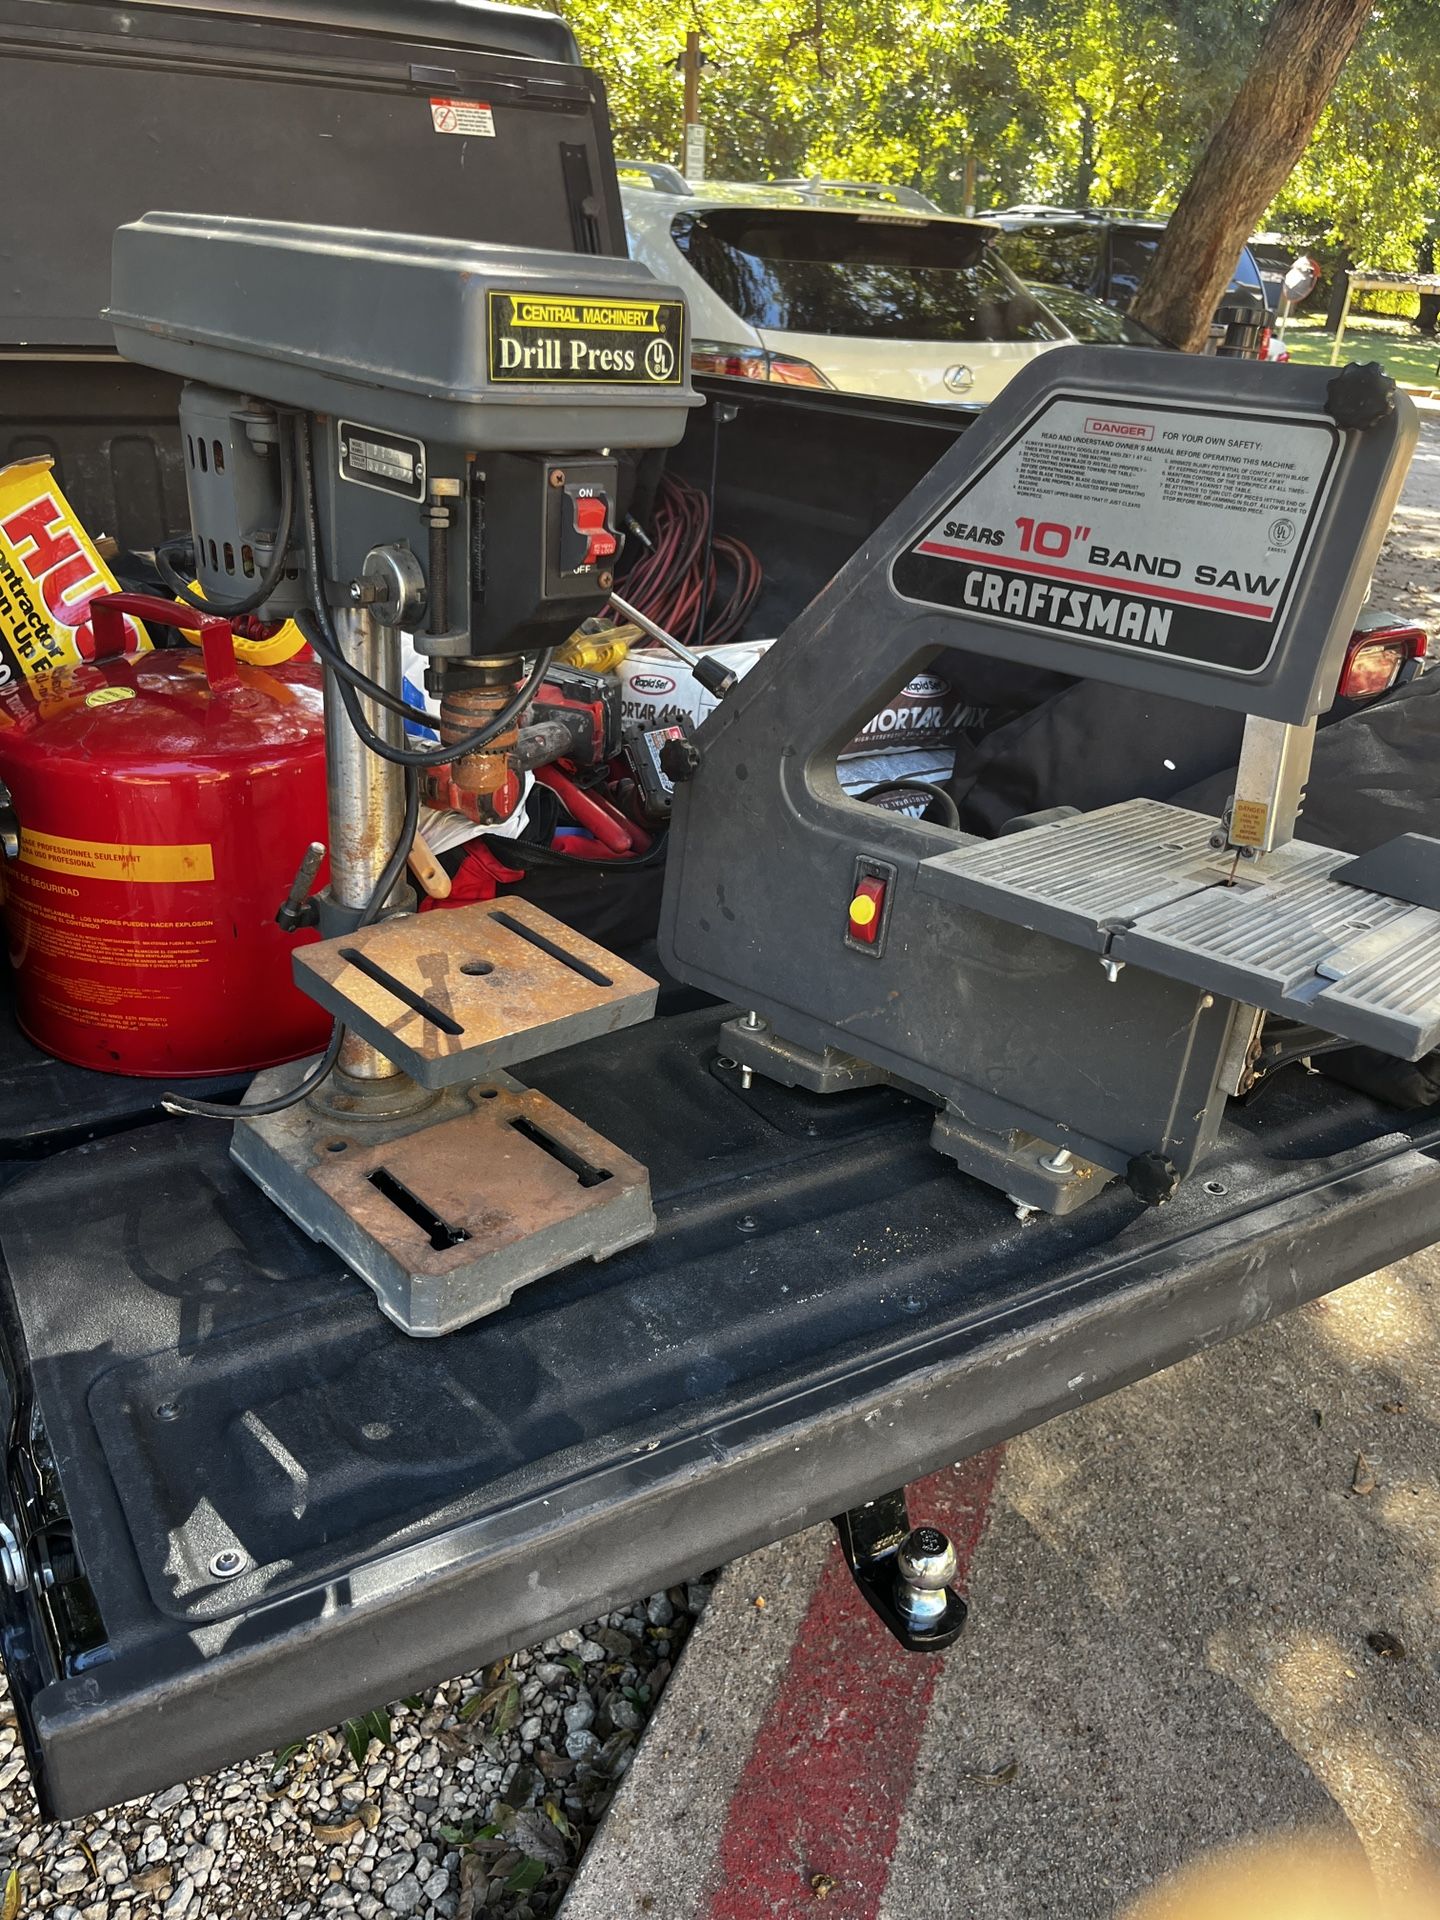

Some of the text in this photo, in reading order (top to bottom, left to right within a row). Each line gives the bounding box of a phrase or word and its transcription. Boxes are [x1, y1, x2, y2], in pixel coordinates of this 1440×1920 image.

[522, 304, 649, 326] CENTRAL MACHINERY
[499, 337, 635, 371] Drill Press
[1092, 422, 1147, 436] DANGER
[1162, 431, 1179, 440] FOR
[1181, 434, 1203, 444] YOUR
[1205, 436, 1226, 446] OWN
[1042, 431, 1057, 440] READ
[1058, 434, 1071, 443] AND
[1073, 436, 1114, 449] UNDERSTAND
[1145, 444, 1173, 456] MANUAL
[1176, 448, 1201, 458] BEFORE
[1203, 452, 1241, 464] OPERATING
[1243, 457, 1259, 466] THIS
[1211, 464, 1239, 473] POTENTIAL
[1249, 470, 1276, 478] CONTACT
[578, 488, 593, 497] ON
[943, 516, 1281, 597] SEARS 10" BAND SAW
[0, 550, 64, 657] ontractor
[963, 571, 1174, 646] CRAFTSMAN
[635, 678, 668, 690] Rapid Set
[621, 701, 656, 720] ORTAR
[943, 702, 990, 729] MIX
[1237, 805, 1265, 814] DANGER
[34, 850, 47, 860] USO
[48, 853, 97, 869] PROFESIONAL
[37, 841, 93, 859] PROFESSIONNEL
[94, 852, 141, 863] SEULEMENT
[20, 873, 80, 897] DE SEGURIDAD
[66, 919, 100, 930] CONTENIDO
[93, 917, 122, 926] VAPORES
